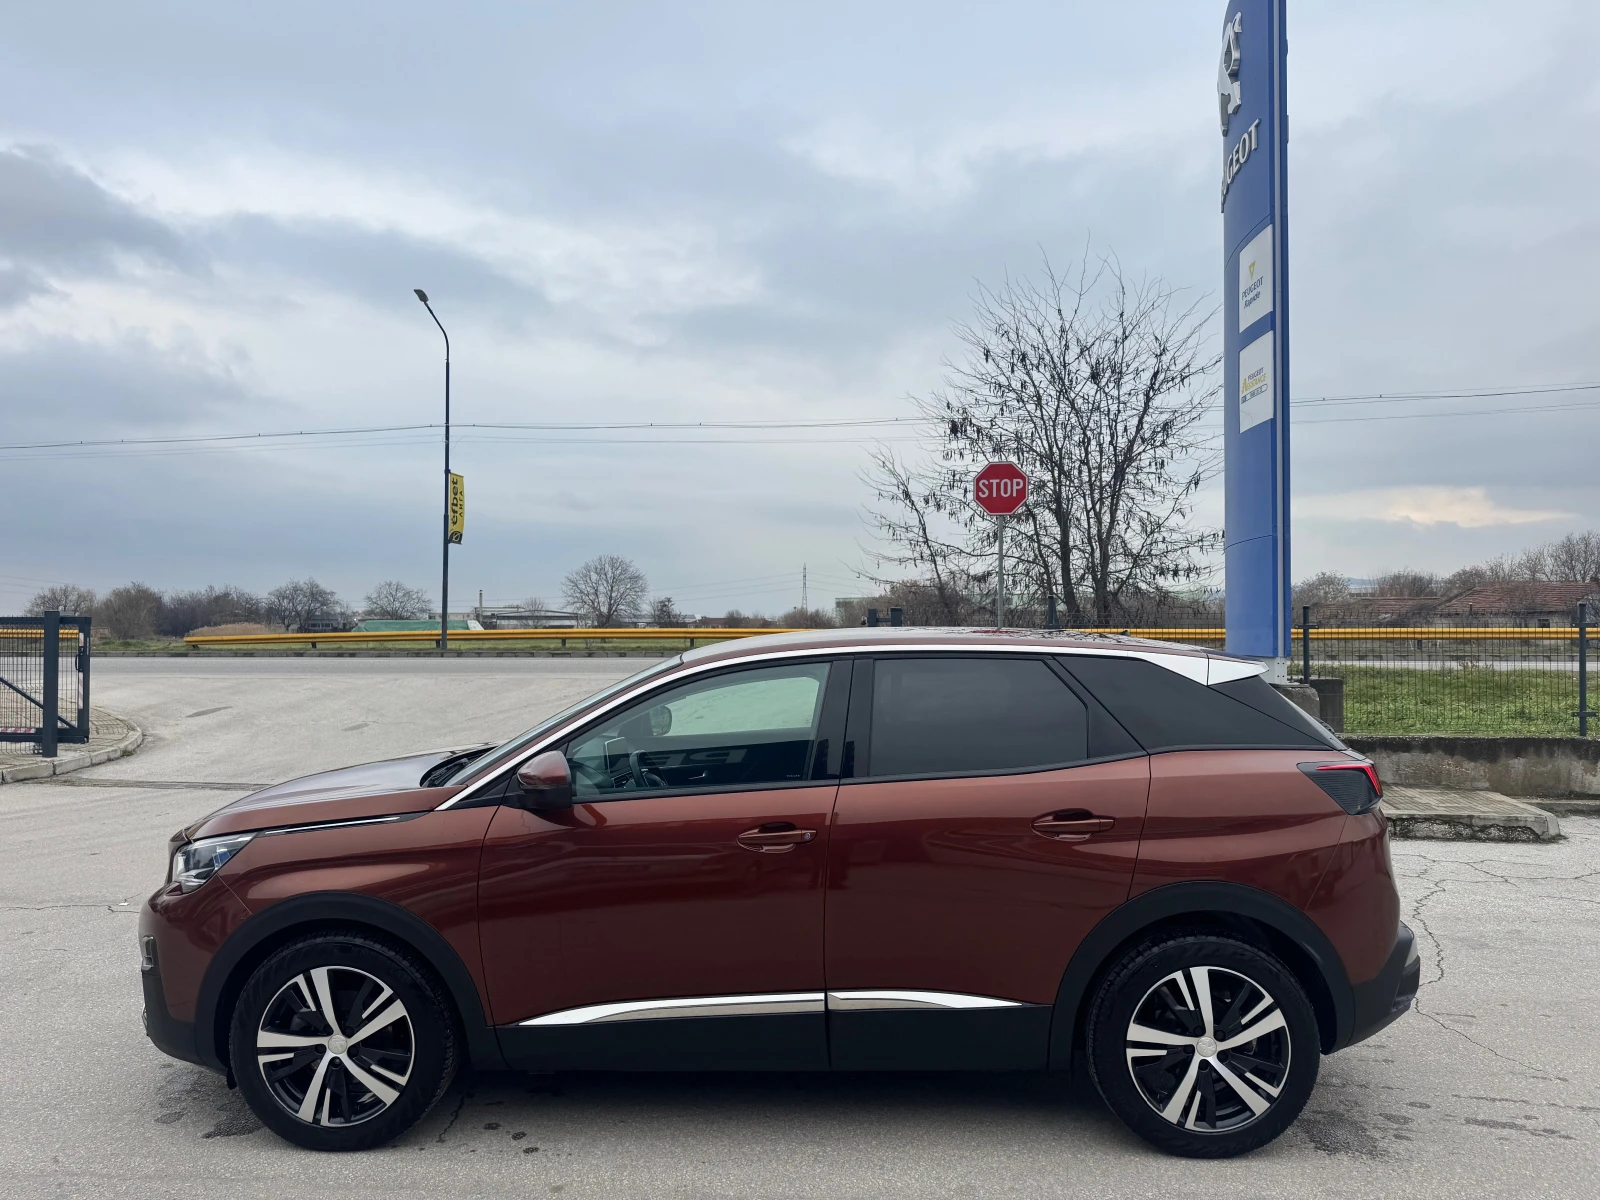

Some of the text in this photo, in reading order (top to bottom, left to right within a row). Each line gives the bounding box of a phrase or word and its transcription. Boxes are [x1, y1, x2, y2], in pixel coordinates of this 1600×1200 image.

[1241, 276, 1264, 300] PEUGEOT
[978, 478, 1024, 498] STOP
[451, 477, 459, 526] efbet
